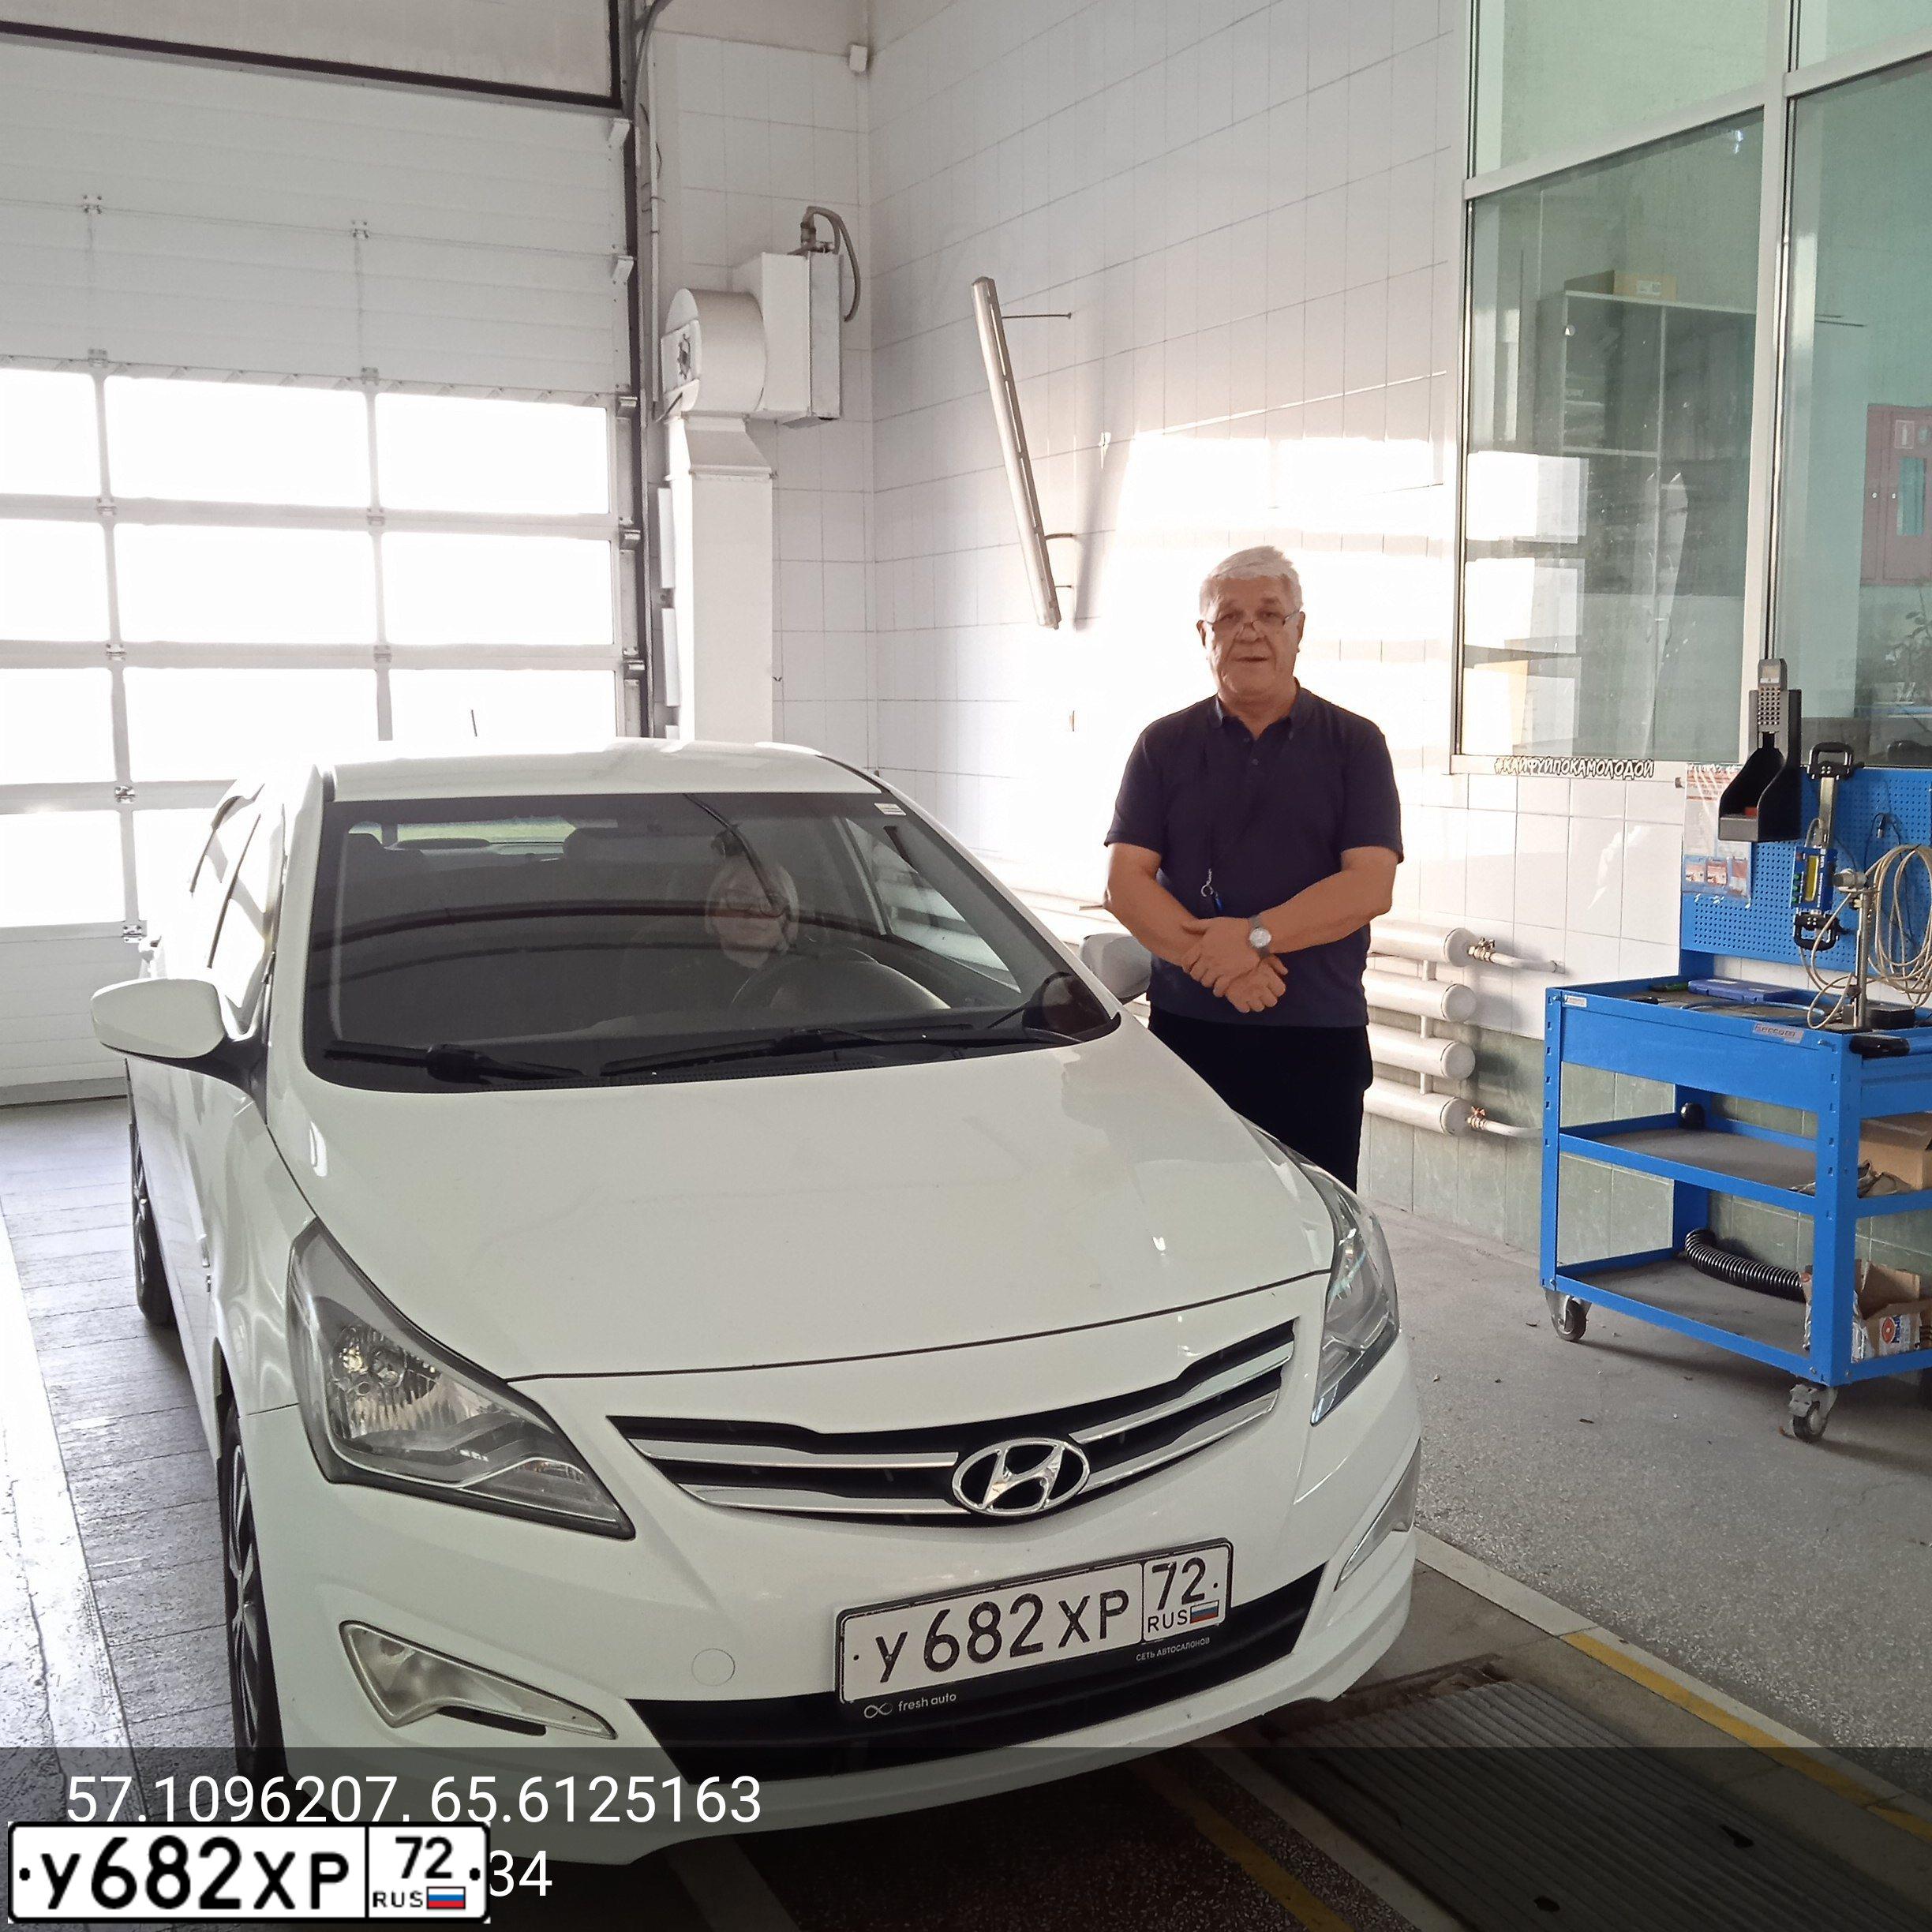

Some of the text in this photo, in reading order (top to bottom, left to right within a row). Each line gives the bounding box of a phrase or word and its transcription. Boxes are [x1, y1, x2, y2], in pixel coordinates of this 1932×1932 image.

[1152, 1557, 1206, 1611] 72
[1148, 1609, 1188, 1633] RUS
[1136, 1637, 1211, 1661] СЕТЬ АВТОСАЛОНОВ
[898, 1693, 957, 1712] fresh auto
